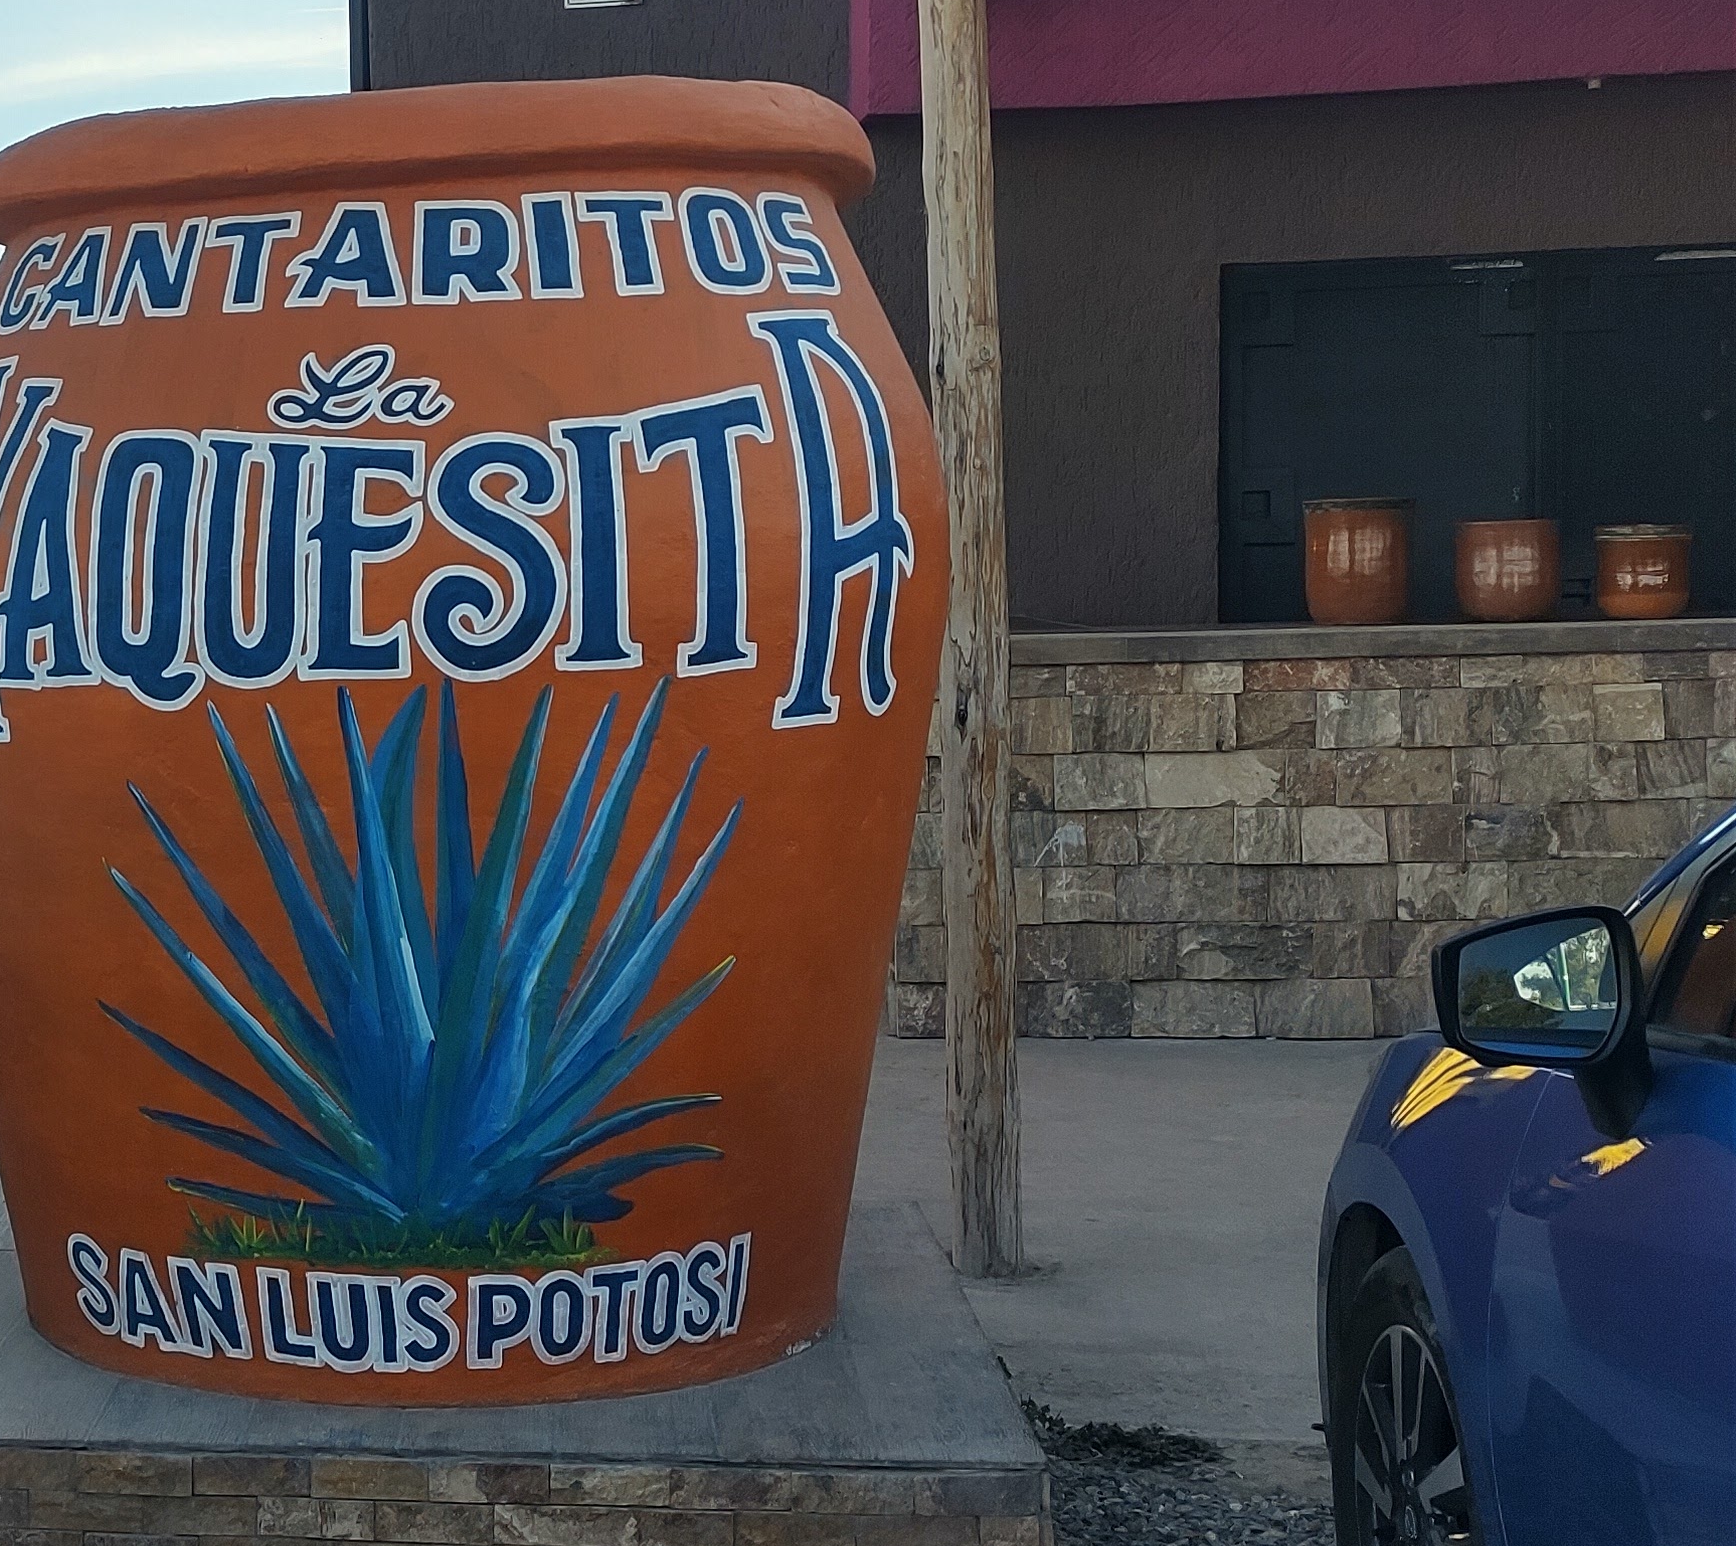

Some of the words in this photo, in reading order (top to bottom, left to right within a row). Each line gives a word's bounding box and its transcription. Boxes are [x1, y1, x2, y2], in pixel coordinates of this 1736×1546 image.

[267, 342, 454, 431] La
[67, 1232, 253, 1360] SAN
[264, 1266, 460, 1373] LUIS
[465, 1231, 753, 1370] POTOSI
